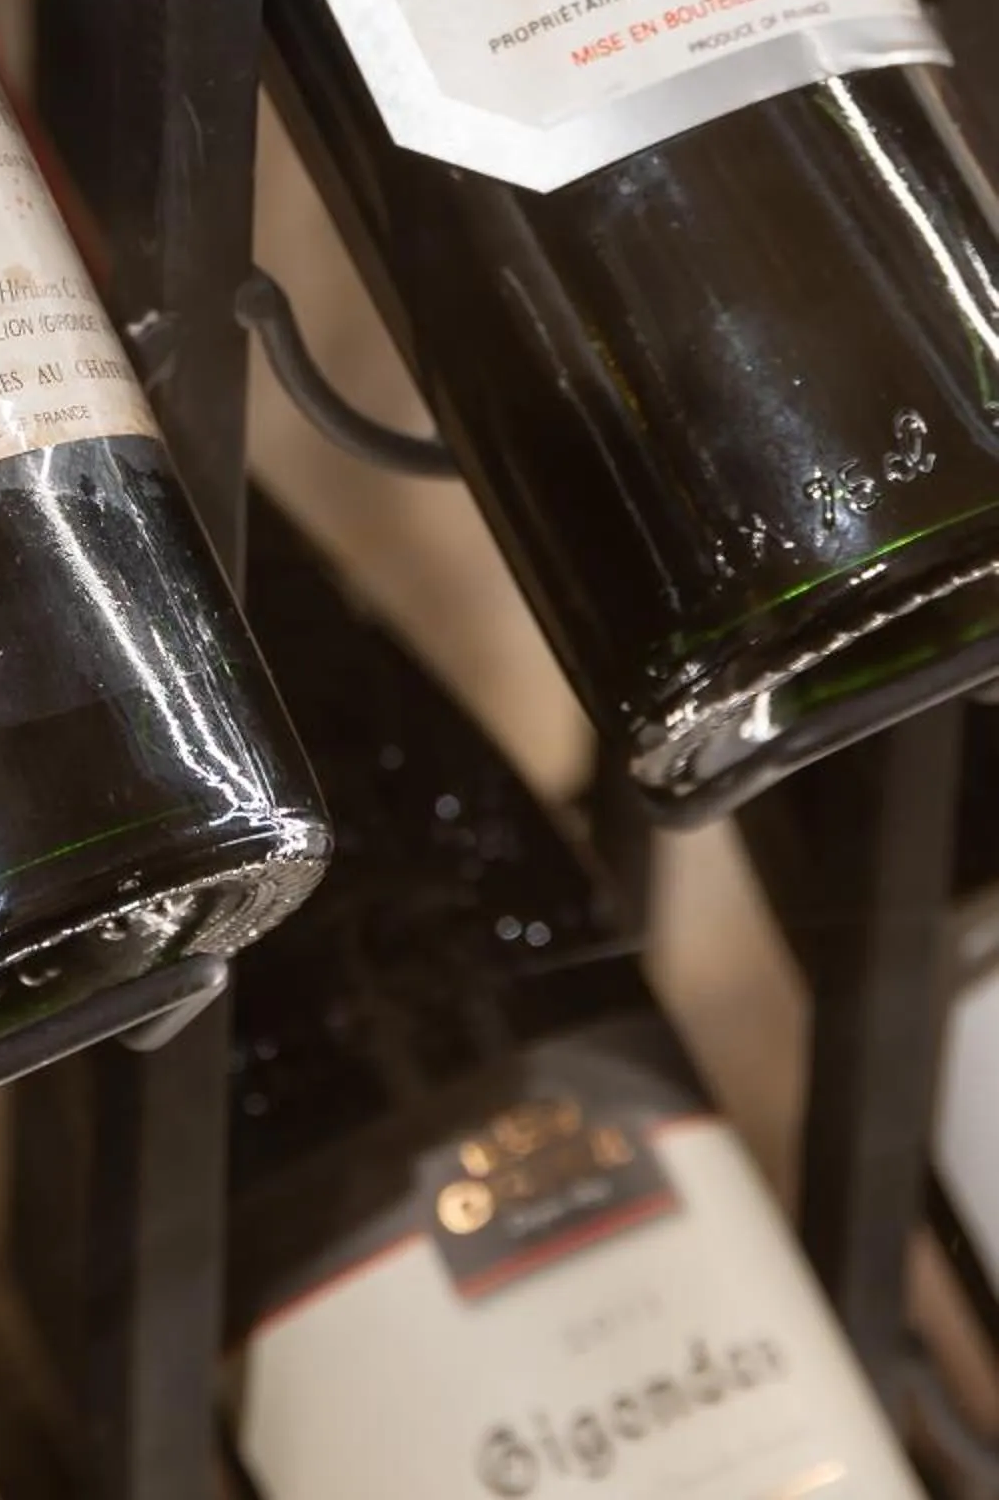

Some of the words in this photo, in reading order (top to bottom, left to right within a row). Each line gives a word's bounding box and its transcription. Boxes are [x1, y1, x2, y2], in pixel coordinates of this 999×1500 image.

[570, 32, 626, 67] MISE
[629, 19, 659, 43] EN
[38, 362, 64, 385] AU
[33, 404, 91, 427] FRANCE
